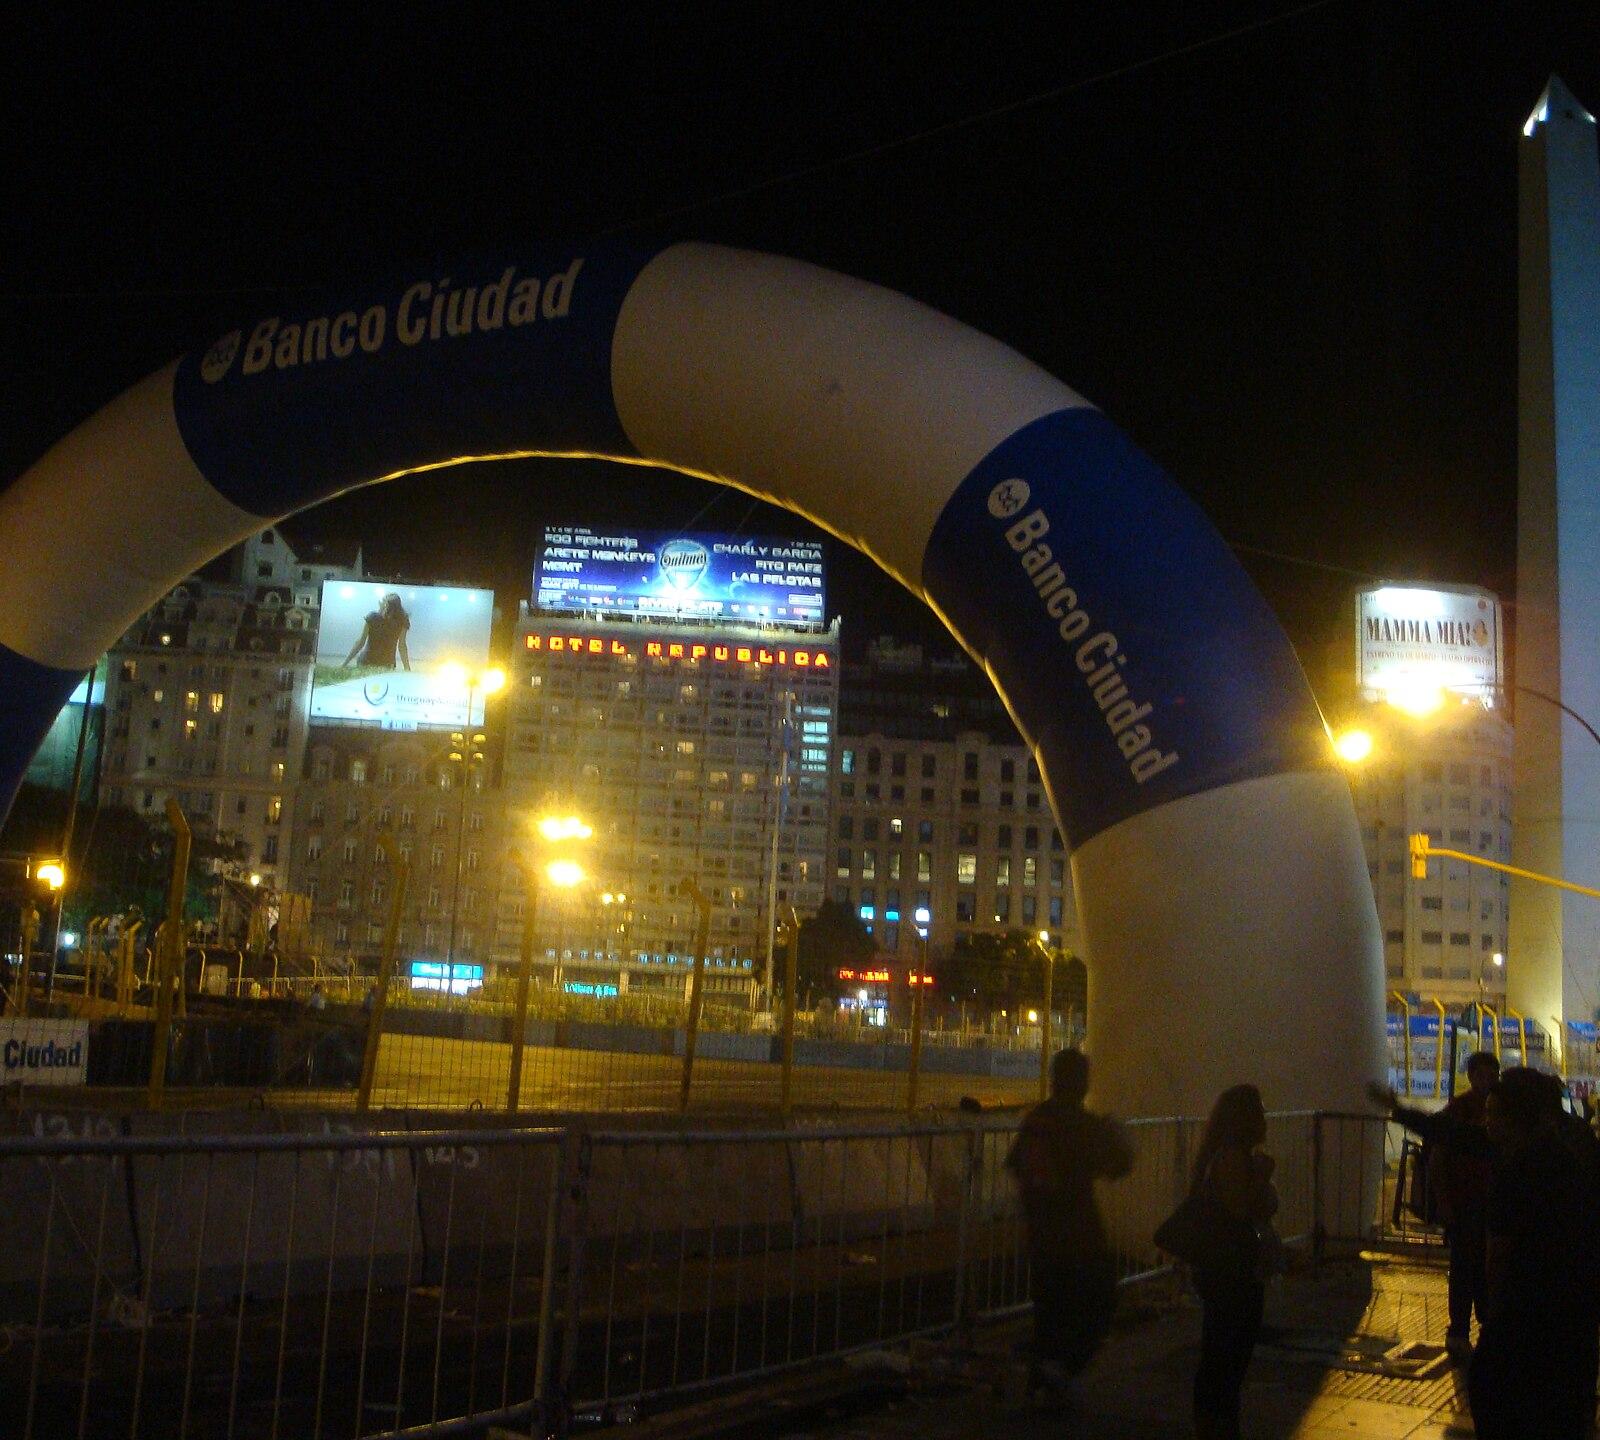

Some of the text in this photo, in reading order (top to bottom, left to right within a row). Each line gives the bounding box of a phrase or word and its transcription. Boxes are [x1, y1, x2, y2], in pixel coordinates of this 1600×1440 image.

[242, 258, 585, 375] Banco Ciudad
[544, 533, 638, 549] FOO FIGHTERS
[713, 543, 768, 556] CHARLY
[543, 547, 656, 563] ARCTIC MONKEYS
[542, 560, 583, 573] MGMT
[755, 560, 822, 574] FITO PAEZ
[731, 571, 822, 588] LAS PELOTAS
[1366, 617, 1471, 646] MAMMA MIA!
[526, 634, 829, 668] HOTEL REPUBLICA
[1004, 507, 1180, 785] Banco Ciudad
[3, 1040, 83, 1069] Ciudad
